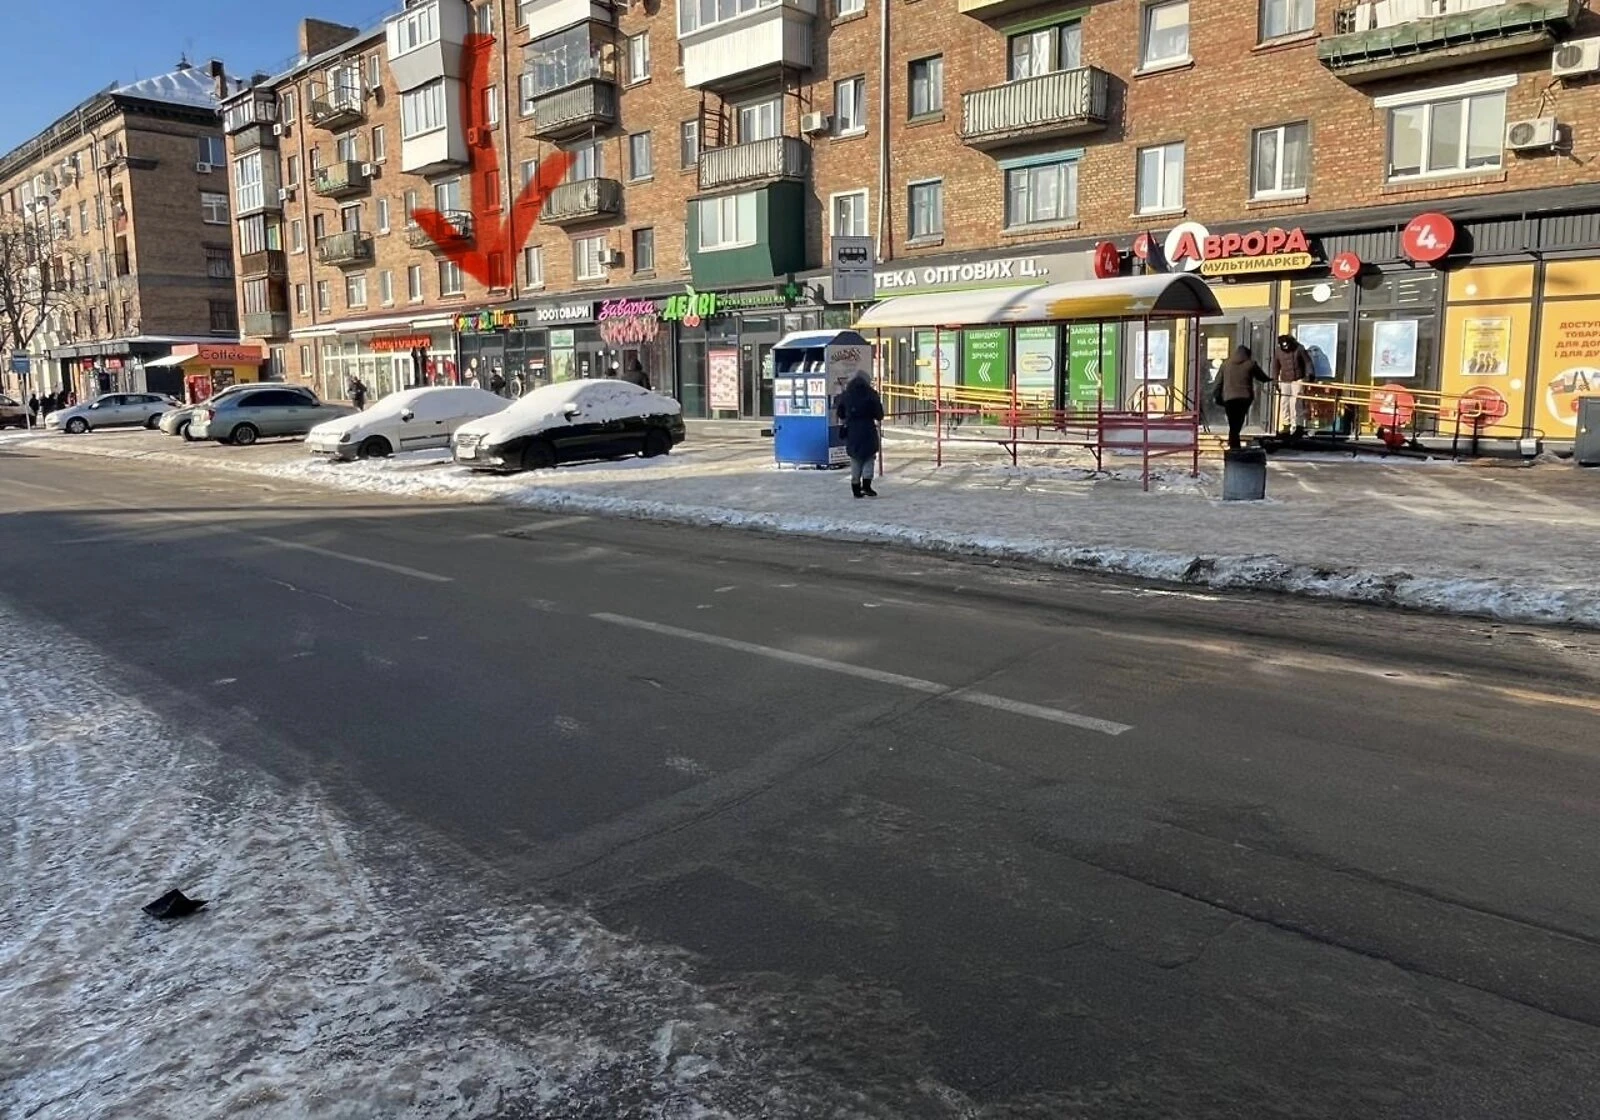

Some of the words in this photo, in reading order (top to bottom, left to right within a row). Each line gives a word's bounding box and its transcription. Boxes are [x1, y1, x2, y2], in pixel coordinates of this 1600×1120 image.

[1173, 227, 1310, 262] АВРОРА
[1416, 224, 1437, 250] 4
[924, 261, 1013, 283] ОПТОВИХ
[1203, 254, 1309, 272] МУЛЬТИМАРКЕТ
[1339, 259, 1351, 273] 4
[537, 305, 589, 321] ЗООТОВАРИ
[1560, 350, 1582, 358] ДЛЯ
